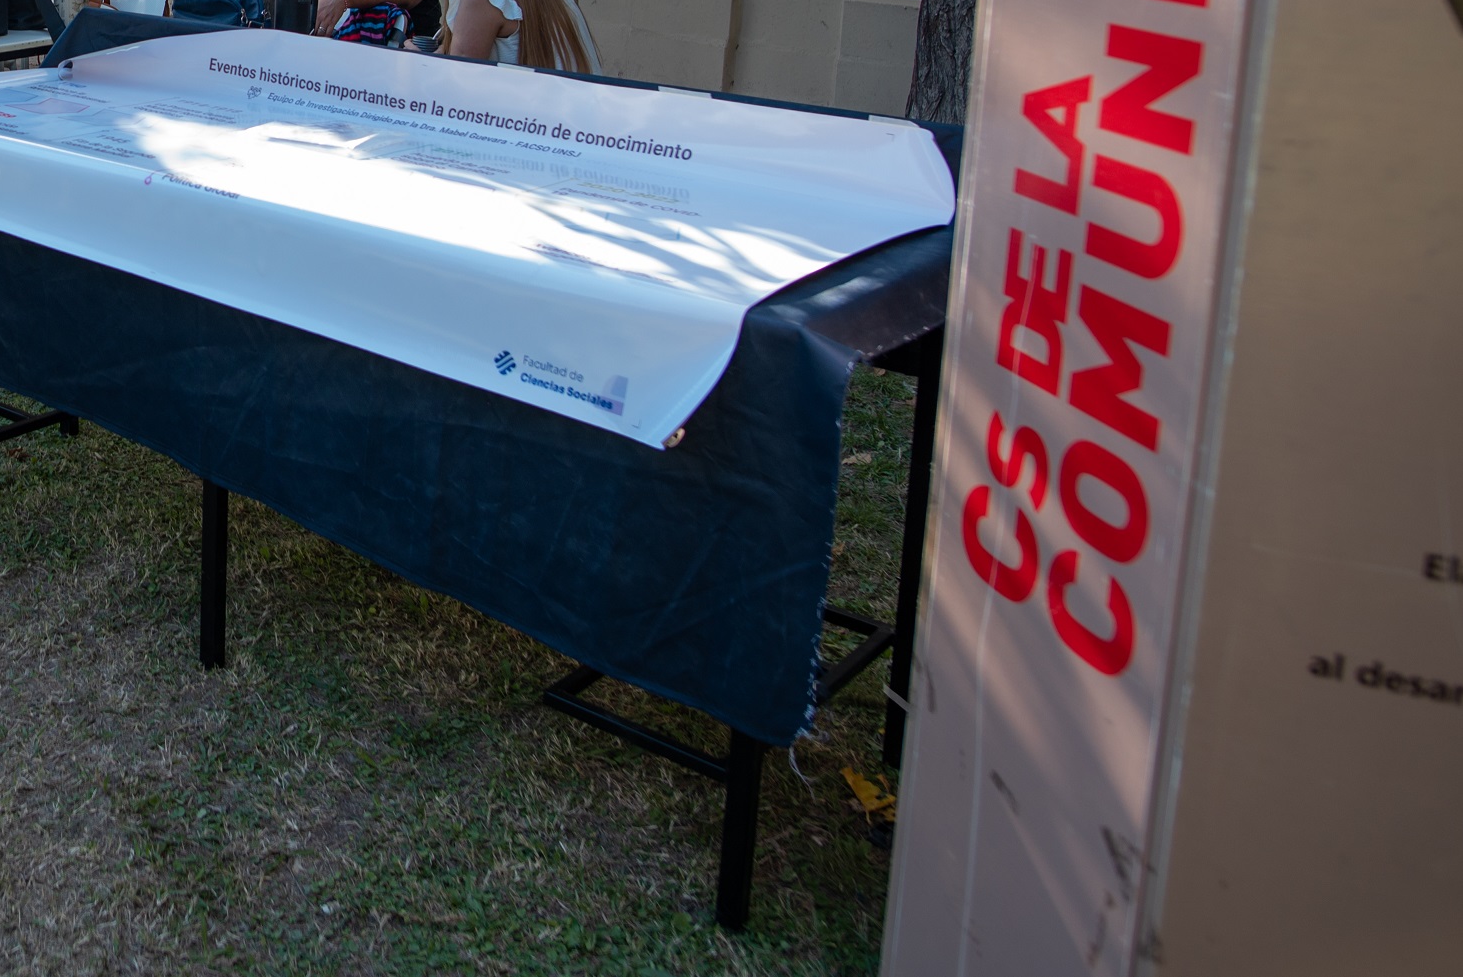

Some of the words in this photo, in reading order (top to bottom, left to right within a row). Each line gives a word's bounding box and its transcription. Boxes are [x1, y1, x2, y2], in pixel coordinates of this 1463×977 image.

[209, 57, 256, 79] Eventos
[259, 67, 322, 93] históricos
[324, 80, 406, 109] importantes
[410, 98, 427, 114] en
[431, 100, 444, 117] la
[448, 105, 547, 136] construcción
[551, 123, 572, 140] de
[575, 129, 693, 161] conocimiento
[267, 92, 293, 104] Equipo
[295, 98, 306, 107] de
[305, 100, 360, 118] Investigación
[360, 110, 393, 124] Dirigido
[393, 118, 410, 128] por
[410, 119, 419, 128] la
[419, 122, 437, 132] Dra.
[439, 126, 469, 138] Mabel
[469, 131, 508, 145] Guevara
[515, 141, 551, 153] FACSO
[551, 147, 582, 159] UNSJ
[1012, 74, 1094, 216] LA
[996, 228, 1074, 398] DE
[520, 372, 565, 394] Ciencias
[567, 387, 613, 410] Sociales
[523, 355, 567, 377] Facultad
[569, 370, 584, 382] de
[1308, 652, 1344, 681] al
